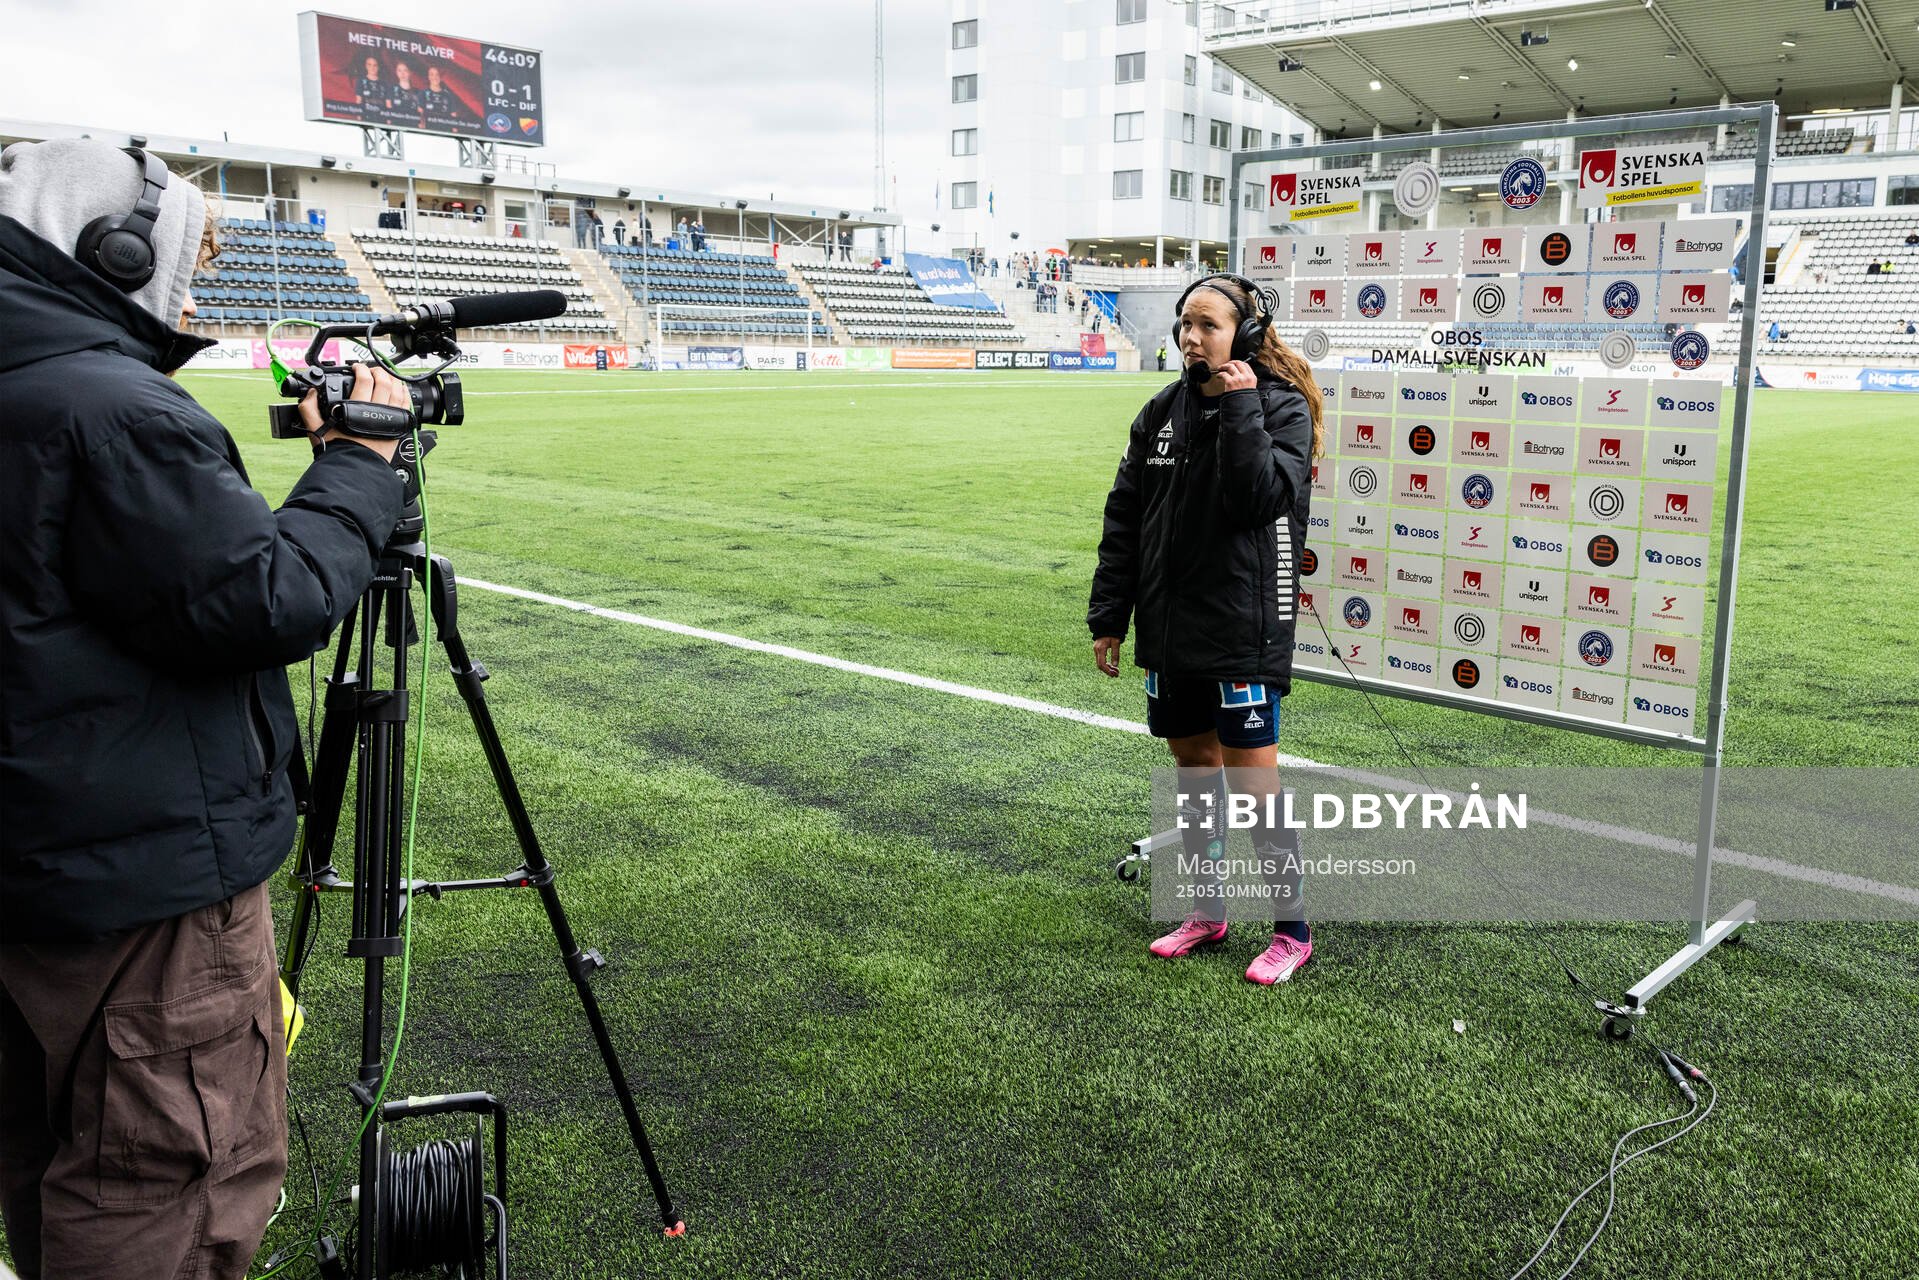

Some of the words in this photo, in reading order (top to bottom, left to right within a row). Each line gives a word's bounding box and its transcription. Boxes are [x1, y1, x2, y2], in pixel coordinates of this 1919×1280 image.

[348, 31, 381, 47] MEET
[383, 38, 408, 53] THE
[411, 43, 455, 60] PLAYER
[485, 47, 537, 69] 46:09
[491, 80, 504, 96] 0
[522, 85, 532, 101] 1
[488, 97, 509, 108] LFC
[519, 101, 537, 112] DIF
[1622, 151, 1704, 171] SVENSKA
[1300, 176, 1361, 192] SVENSKA
[1620, 171, 1662, 187] SPEL
[1300, 193, 1331, 206] SPEL
[1613, 191, 1646, 202] Fotbollens
[1646, 185, 1694, 199] huvudsponsor
[1511, 197, 1531, 205] 2003
[1320, 203, 1355, 216] huvudsponsor
[1687, 241, 1722, 252] Botrygg
[1306, 258, 1332, 266] unisport
[1431, 330, 1482, 346] OBOS
[196, 348, 248, 359] RENA
[516, 352, 559, 365] Botrygg
[977, 352, 1013, 367] SELECT
[1015, 352, 1049, 367] SELECT
[1372, 349, 1546, 368] DAMALLSVENSKAN
[757, 357, 785, 366] PARS
[1063, 356, 1081, 366] OBOS
[1097, 356, 1114, 366] OBOS
[1868, 373, 1897, 387] Heja
[1358, 389, 1385, 400] Botrygg
[1417, 391, 1447, 401] OBOS
[1469, 397, 1497, 408] unisport
[1540, 395, 1573, 407] OBOS
[1678, 401, 1715, 412] OBOS
[362, 411, 393, 421] SONY
[1533, 443, 1564, 455] Botrygg
[1147, 456, 1175, 467] unisport
[1662, 456, 1696, 467] unisport
[1348, 527, 1373, 535] unisport
[1411, 528, 1439, 539] OBOS
[1531, 540, 1562, 552] OBOS
[1665, 554, 1701, 567] OBOS
[1405, 572, 1432, 584] Botrygg
[1519, 593, 1548, 602] unisport
[1578, 605, 1604, 613] SVENSKA
[1298, 643, 1323, 654] OBOS
[1511, 643, 1535, 651] SVENSKA
[1403, 661, 1432, 673] OBOS
[1642, 663, 1668, 671] SVENSKA
[1521, 682, 1552, 694] OBOS
[1582, 690, 1614, 705] Botrygg
[1653, 703, 1689, 717] OBOS
[1244, 721, 1264, 729] SELECT
